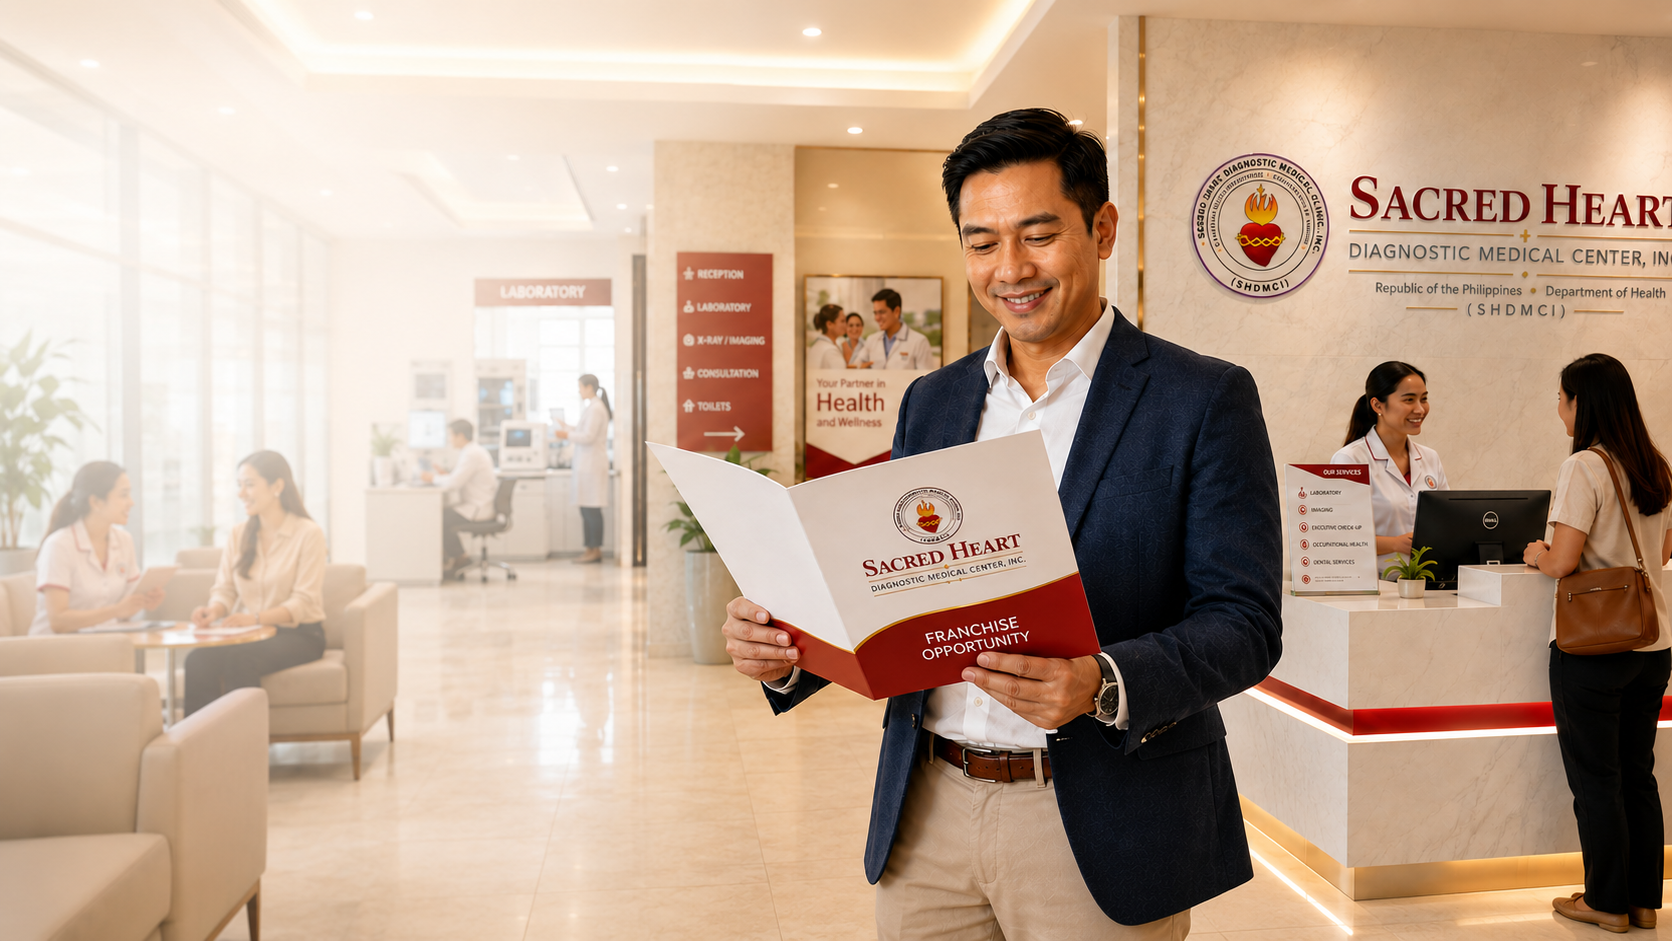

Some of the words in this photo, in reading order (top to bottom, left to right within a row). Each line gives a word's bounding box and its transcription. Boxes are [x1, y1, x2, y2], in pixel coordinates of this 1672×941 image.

[1224, 159, 1277, 177] DIAGNOSTIC
[1349, 176, 1531, 222] SACRED
[1349, 243, 1470, 261] DIAGNOSTIC
[1480, 247, 1564, 263] MEDICAL
[1572, 249, 1647, 268] CENTER,
[1653, 251, 1672, 265] IN
[697, 270, 744, 279] RECEPTION
[500, 285, 586, 298] LABORATORY
[1231, 278, 1290, 292] (SHDMCI)
[1376, 282, 1423, 295] Republic
[1426, 283, 1438, 294] of
[1441, 284, 1459, 295] the
[1462, 284, 1522, 298] Philippines
[1546, 286, 1613, 300] Department
[1616, 286, 1628, 298] of
[1630, 286, 1666, 299] Health
[697, 303, 751, 312] LABORATORY
[1467, 303, 1566, 318] (SHDMCI)
[697, 336, 723, 345] X-RAY
[729, 336, 765, 345] IMAGING
[697, 369, 759, 378] CONSULTATION
[817, 379, 838, 388] Your
[841, 379, 874, 388] Partner
[877, 379, 885, 388] in
[697, 402, 731, 411] TOILETS
[817, 392, 885, 412] Health
[816, 417, 836, 427] and
[838, 418, 882, 427] Wellness
[862, 550, 944, 577] SACRED
[947, 534, 1020, 560] HEART
[871, 576, 925, 592] DIAGNOSTIC
[928, 568, 967, 581] MEDICAL
[970, 561, 1007, 573] CENTER,
[1008, 556, 1026, 566] INC.
[925, 616, 1019, 644] FRANCHISE
[922, 631, 1029, 660] OPPORTUNITY
